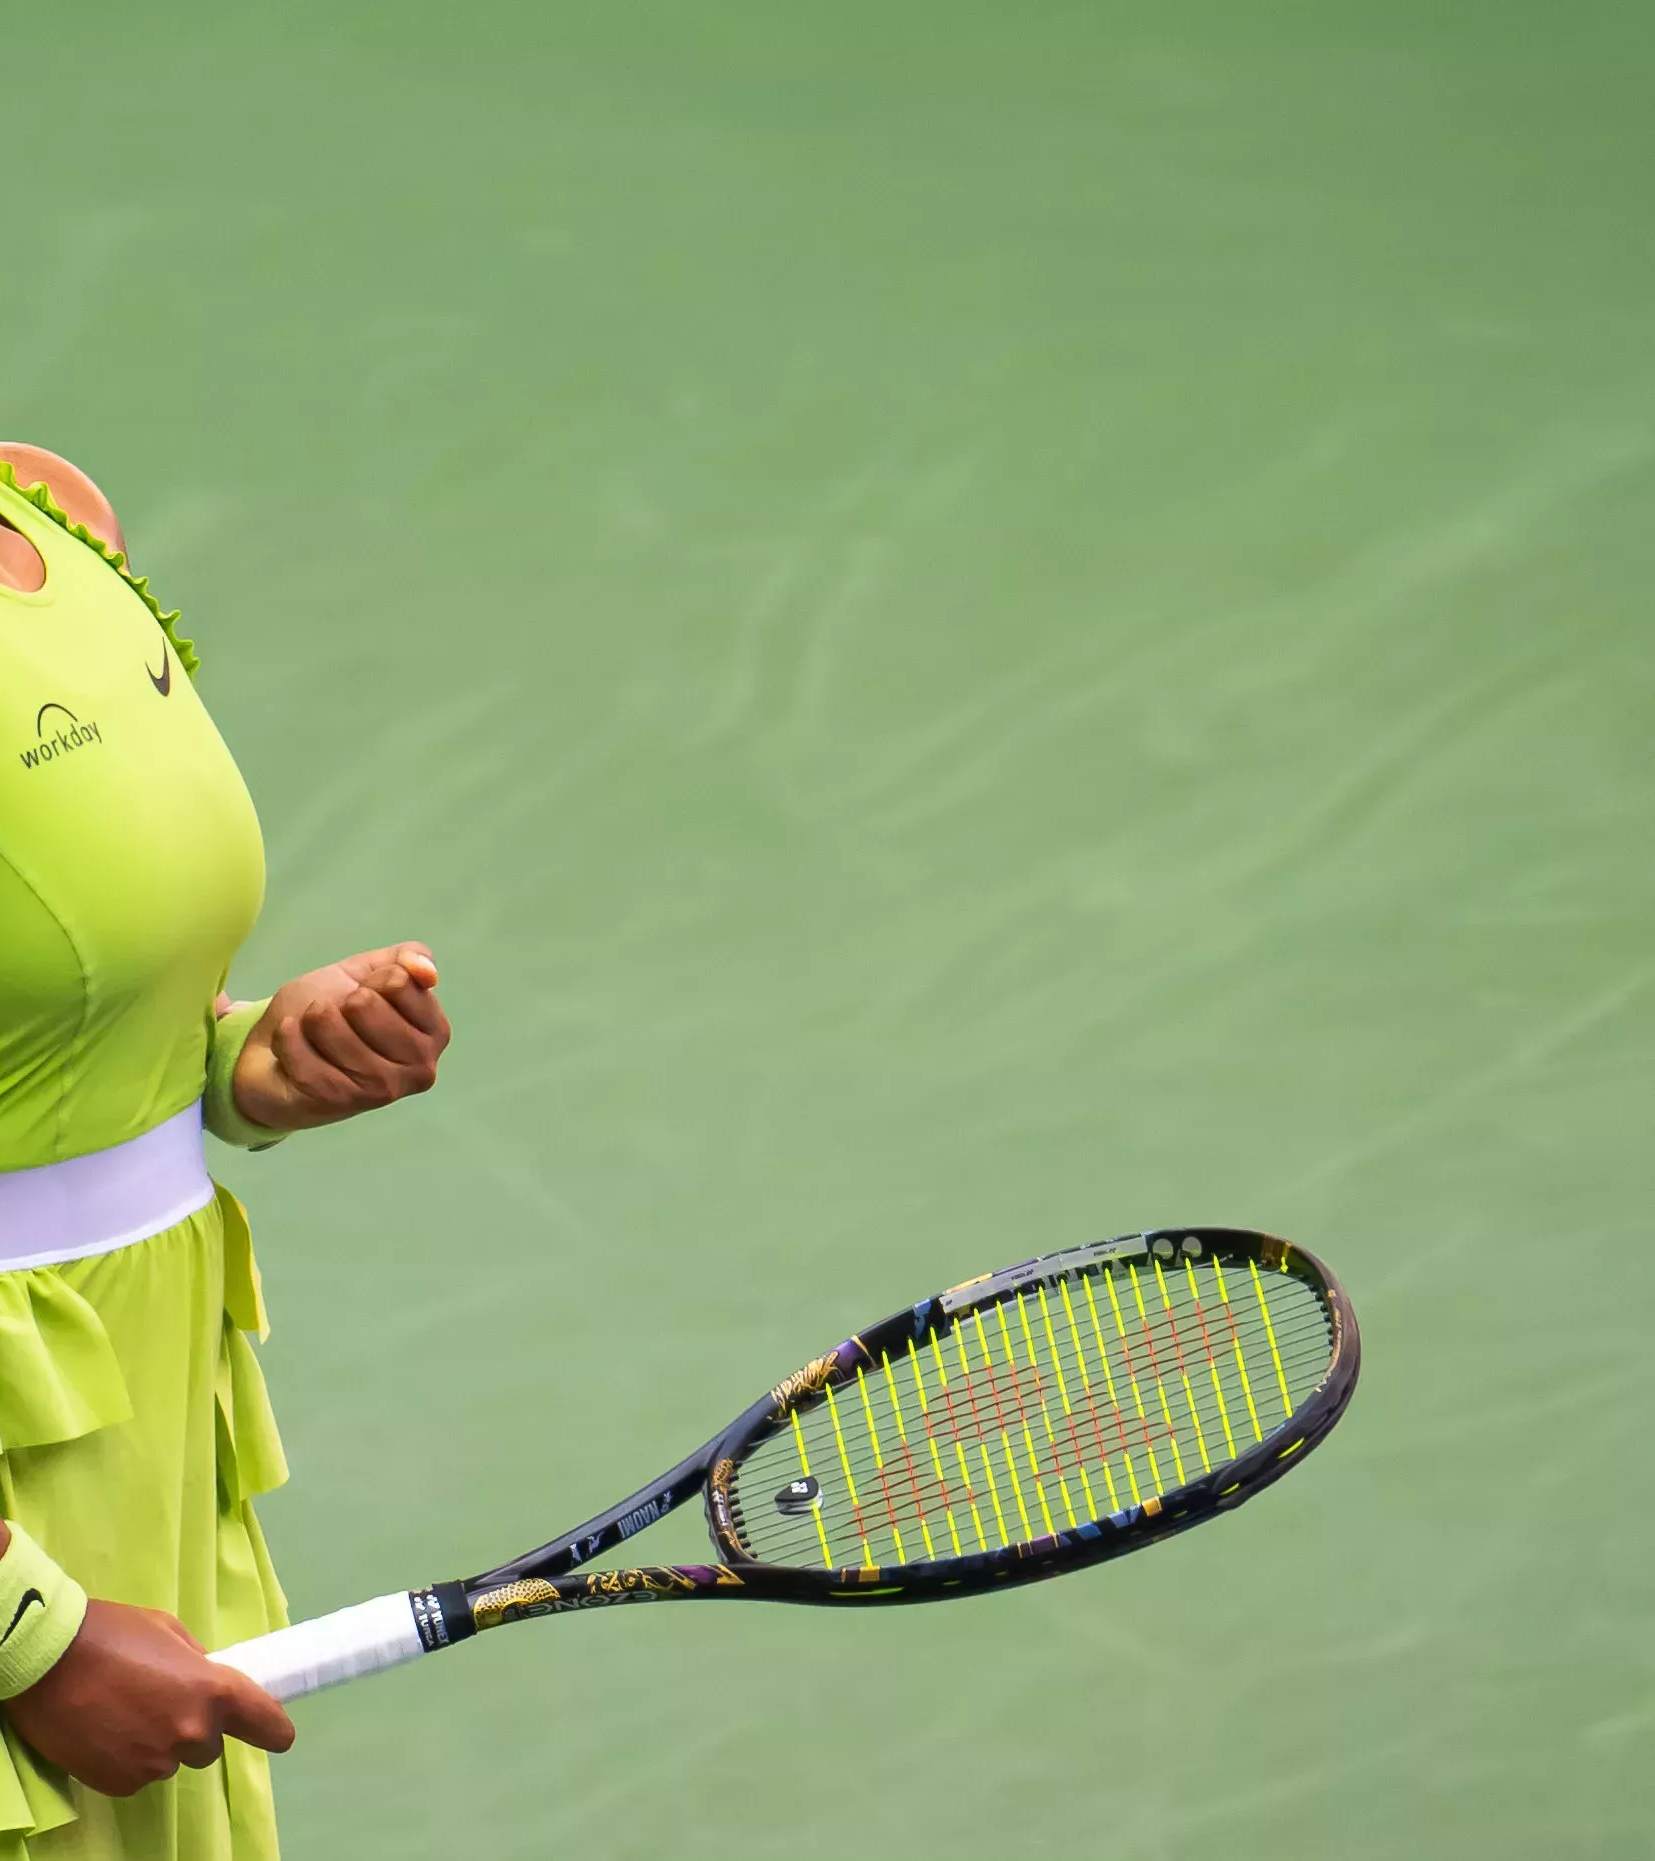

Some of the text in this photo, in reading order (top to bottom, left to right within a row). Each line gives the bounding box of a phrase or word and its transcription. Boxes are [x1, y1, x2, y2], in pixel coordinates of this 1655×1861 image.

[19, 721, 102, 769] workday
[617, 1500, 661, 1539] NAOMI
[525, 1590, 658, 1618] EZONE
